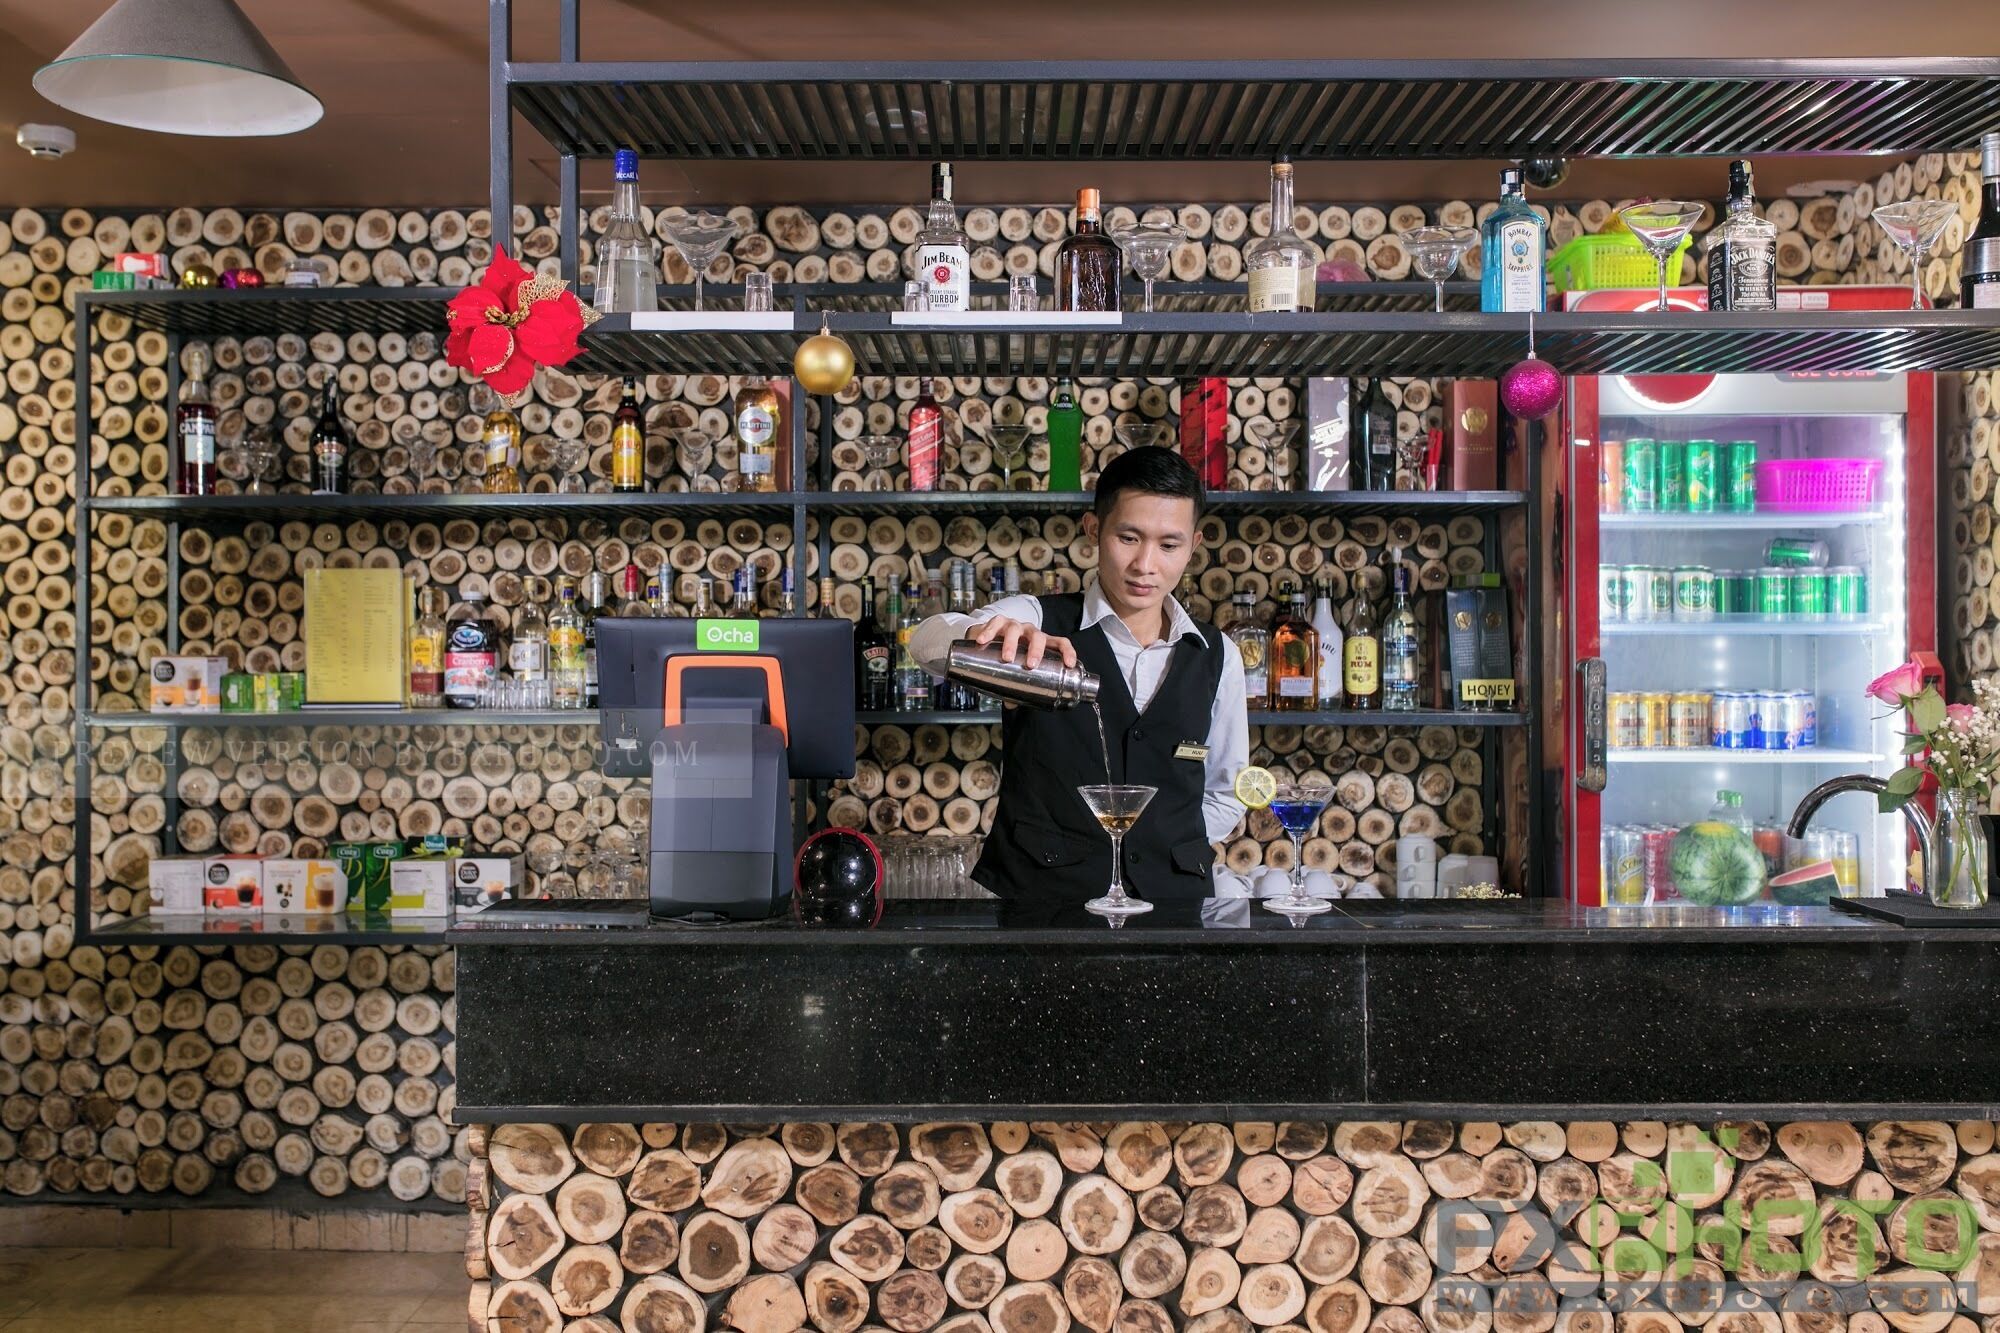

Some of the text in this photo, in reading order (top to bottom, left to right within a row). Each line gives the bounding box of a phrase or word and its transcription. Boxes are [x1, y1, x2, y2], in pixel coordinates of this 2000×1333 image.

[1508, 228, 1532, 238] BOMBAY
[921, 251, 962, 270] JIM BEAM
[1730, 250, 1748, 265] JACK
[1508, 262, 1534, 273] SAPPHIRE
[929, 294, 959, 303] OURBON
[740, 421, 771, 430] MARTINI
[707, 626, 754, 643] Ocha
[452, 656, 490, 668] Cranberry
[1467, 685, 1510, 696] HONEY
[339, 848, 358, 858] Cozy
[375, 847, 396, 857] Cozy
